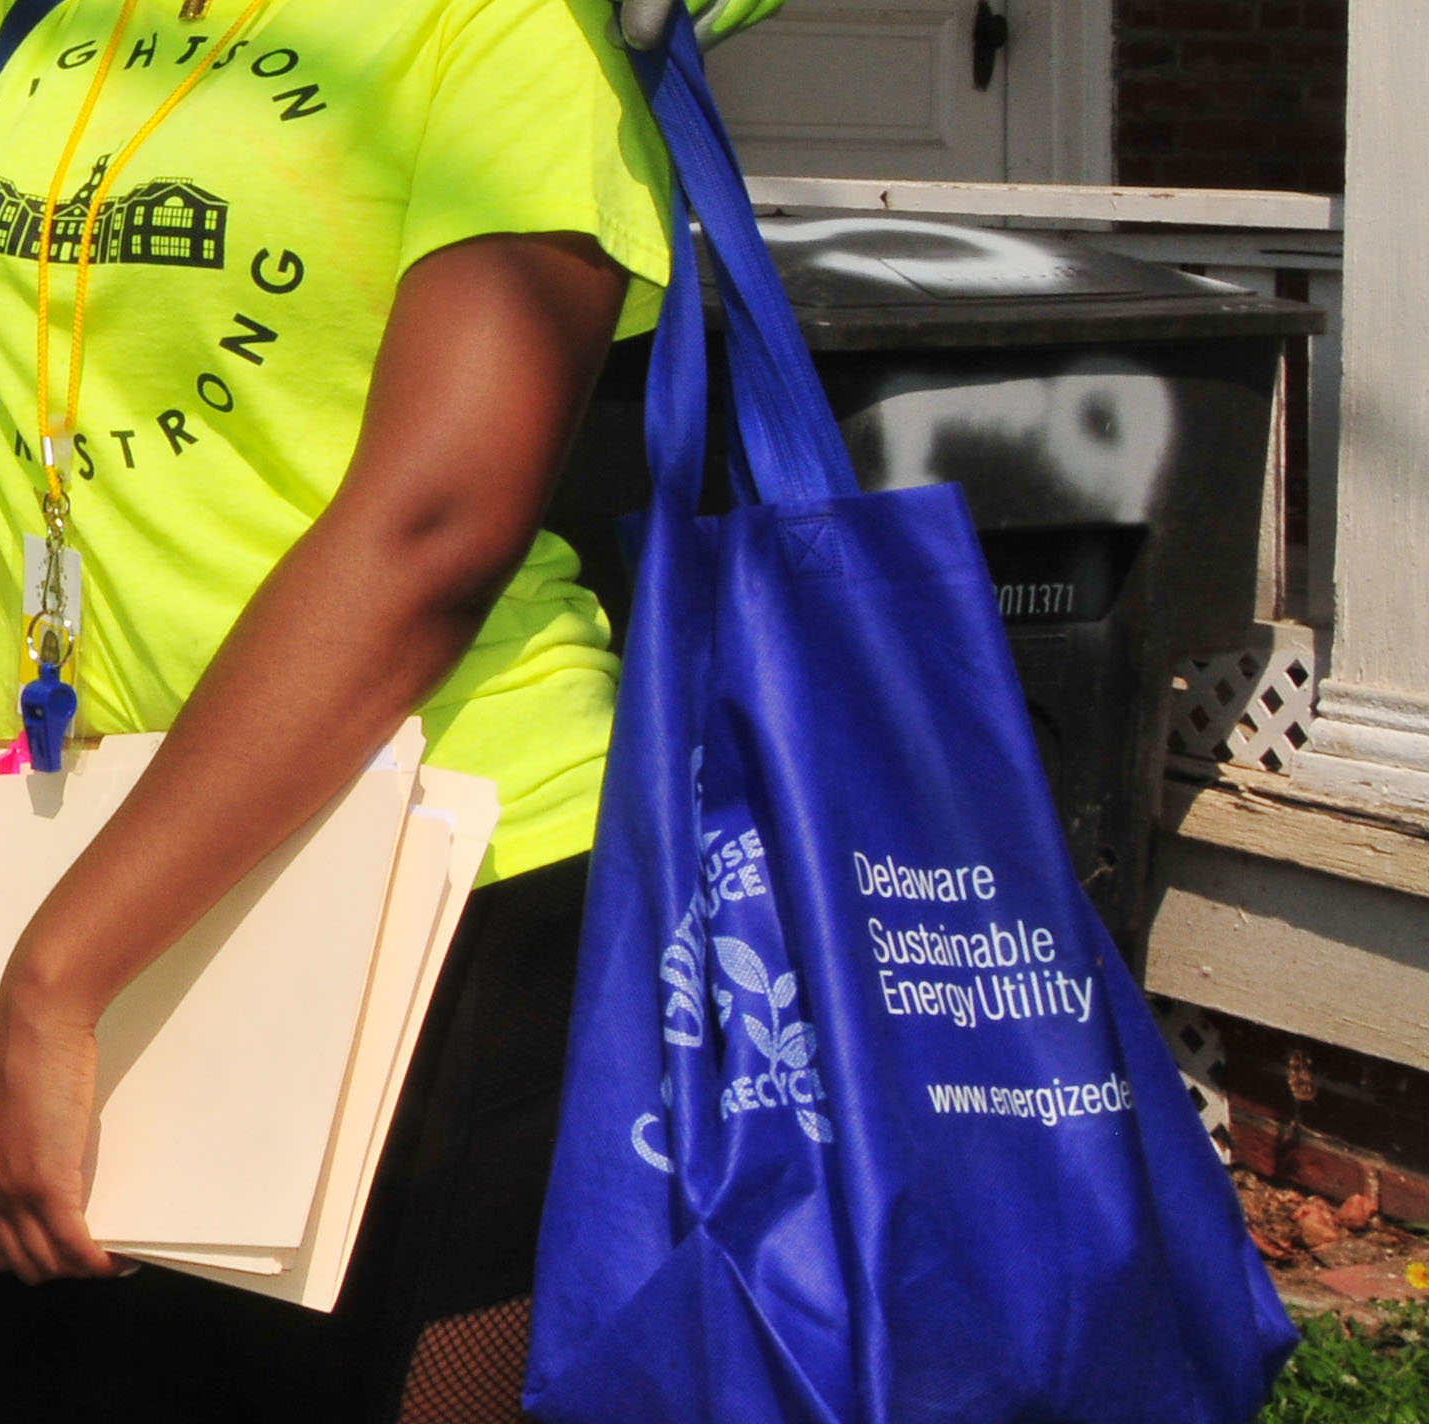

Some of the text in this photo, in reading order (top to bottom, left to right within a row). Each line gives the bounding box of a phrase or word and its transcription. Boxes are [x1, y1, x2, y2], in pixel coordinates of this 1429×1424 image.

[250, 47, 328, 123] ON
[72, 246, 306, 482] STRONG
[992, 583, 1074, 616] 011371
[852, 850, 996, 903] Delaware
[867, 917, 1056, 969] Sustainable
[926, 1071, 1133, 1128] www.energizede
